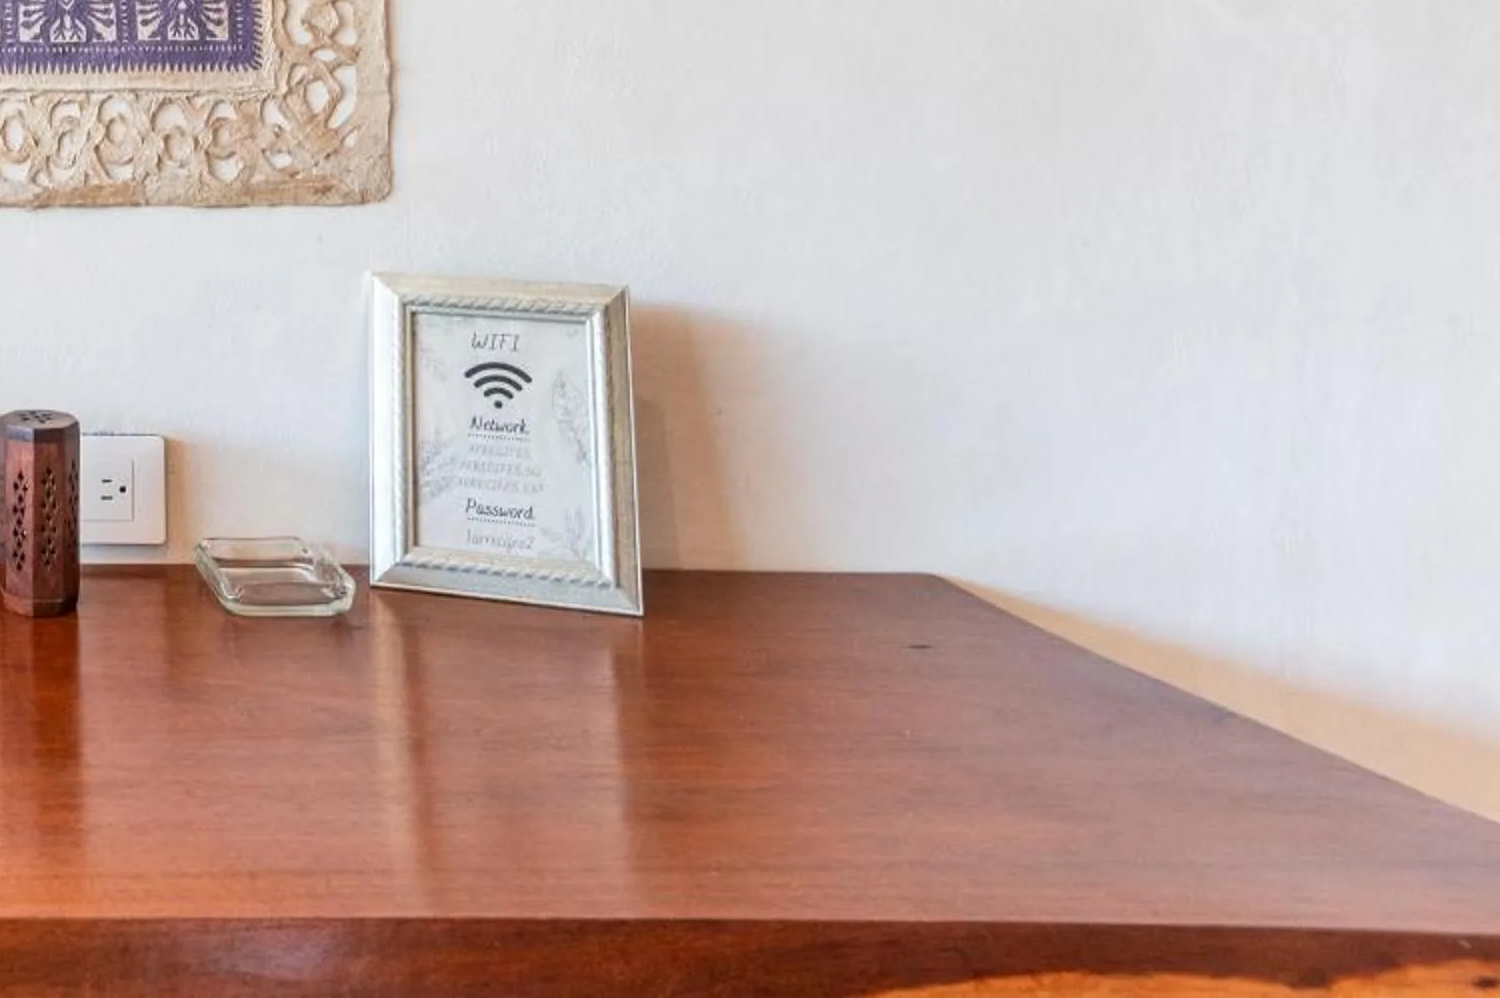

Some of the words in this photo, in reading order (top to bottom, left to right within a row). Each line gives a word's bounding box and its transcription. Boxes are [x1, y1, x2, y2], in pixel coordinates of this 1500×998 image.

[471, 331, 519, 352] WIFI
[470, 415, 529, 434] Network
[465, 497, 534, 520] Password
